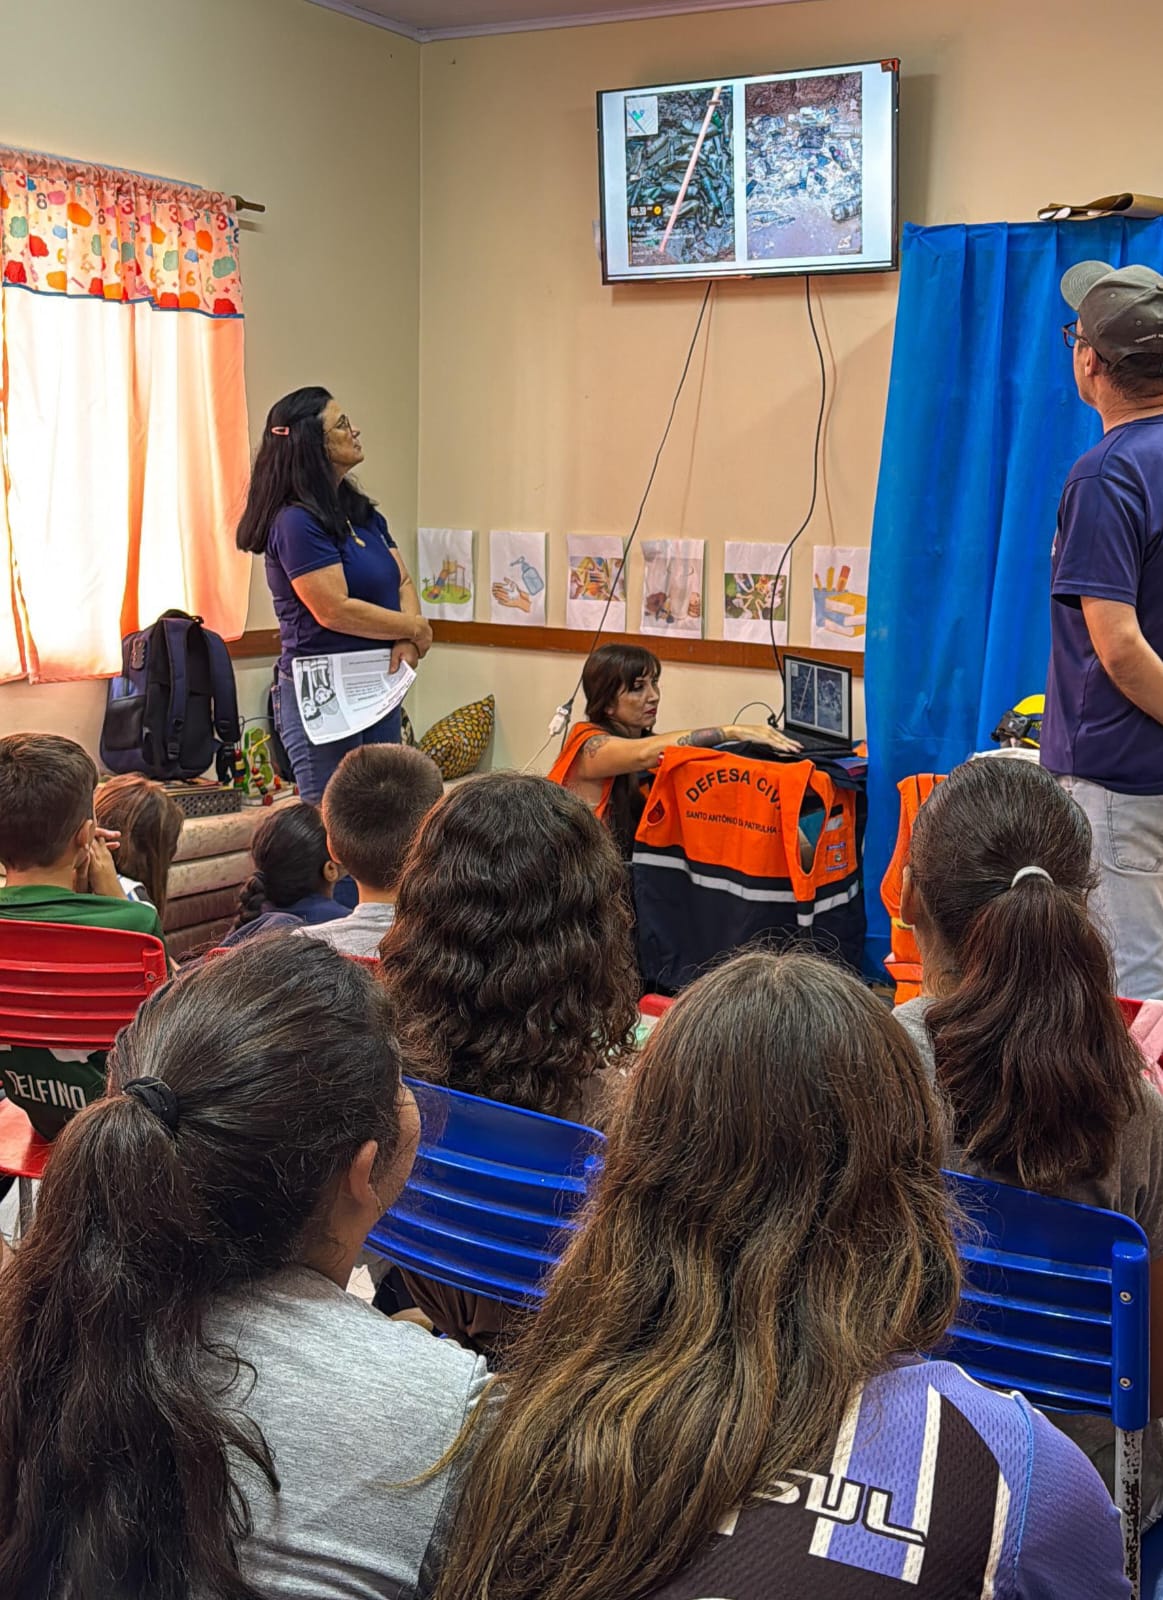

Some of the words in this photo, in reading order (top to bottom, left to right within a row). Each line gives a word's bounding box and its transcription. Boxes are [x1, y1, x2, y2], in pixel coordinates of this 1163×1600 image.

[36, 192, 47, 210] 8
[121, 199, 134, 215] 3
[216, 212, 228, 231] 3
[186, 271, 196, 287] 6
[685, 768, 751, 803] DEFESA
[686, 810, 707, 821] SANTO
[708, 814, 738, 826] ANTÔNIO
[744, 821, 777, 834] PATRULHA
[4, 1069, 88, 1111] DELFINO
